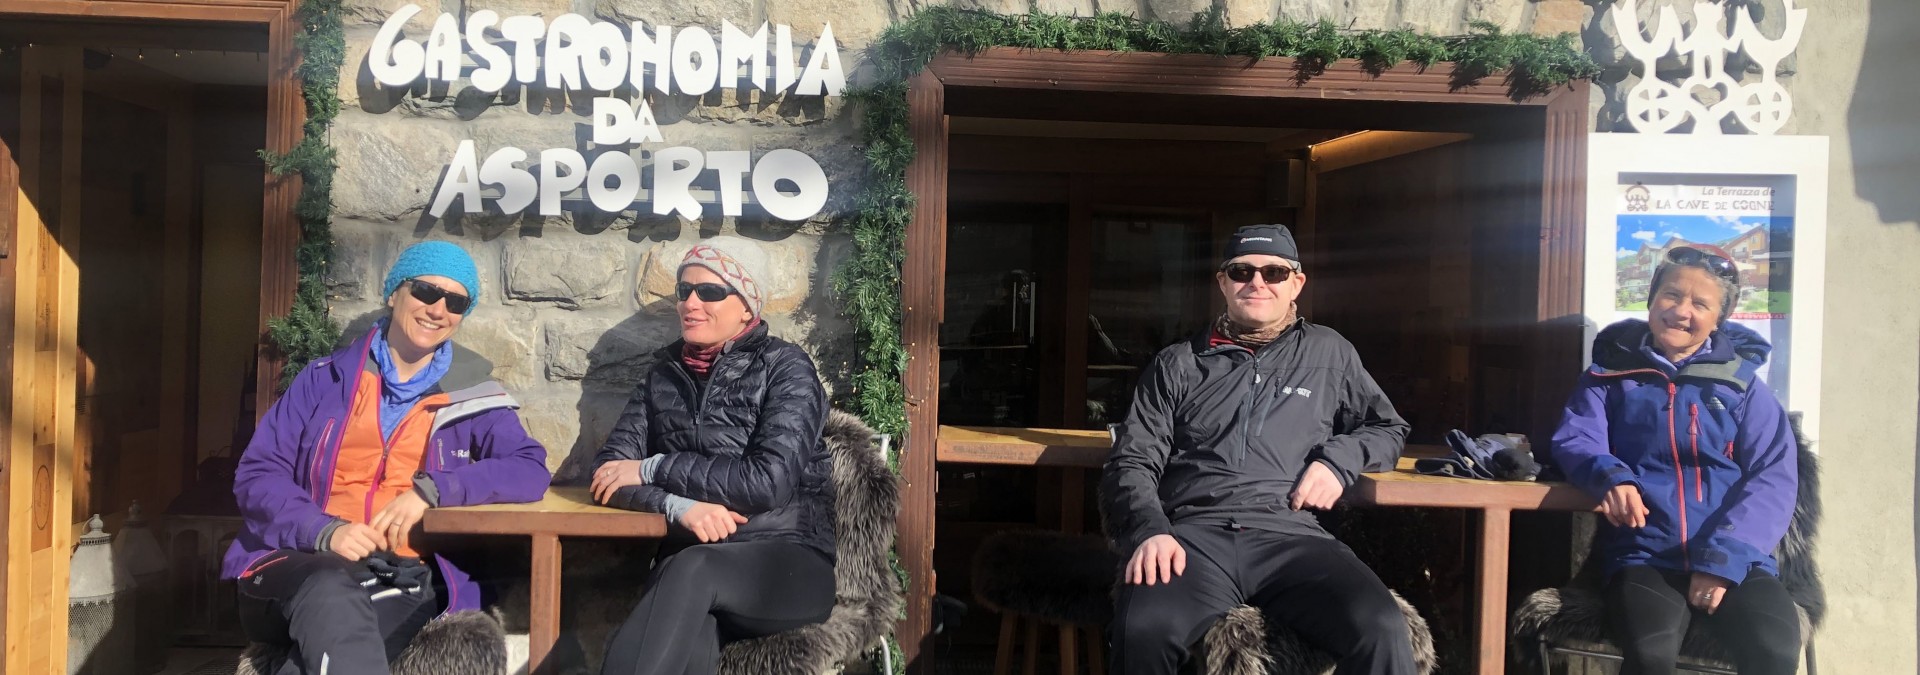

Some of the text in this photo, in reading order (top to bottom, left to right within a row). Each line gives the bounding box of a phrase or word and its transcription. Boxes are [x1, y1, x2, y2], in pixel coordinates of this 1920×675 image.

[368, 4, 846, 96] GASTRONOMIA
[592, 97, 664, 145] DA
[429, 139, 829, 221] ASPORTO
[1702, 187, 1775, 196] La Terrazza de
[1656, 200, 1671, 209] LA
[1677, 200, 1709, 210] CAVE
[1732, 200, 1775, 211] COGNE
